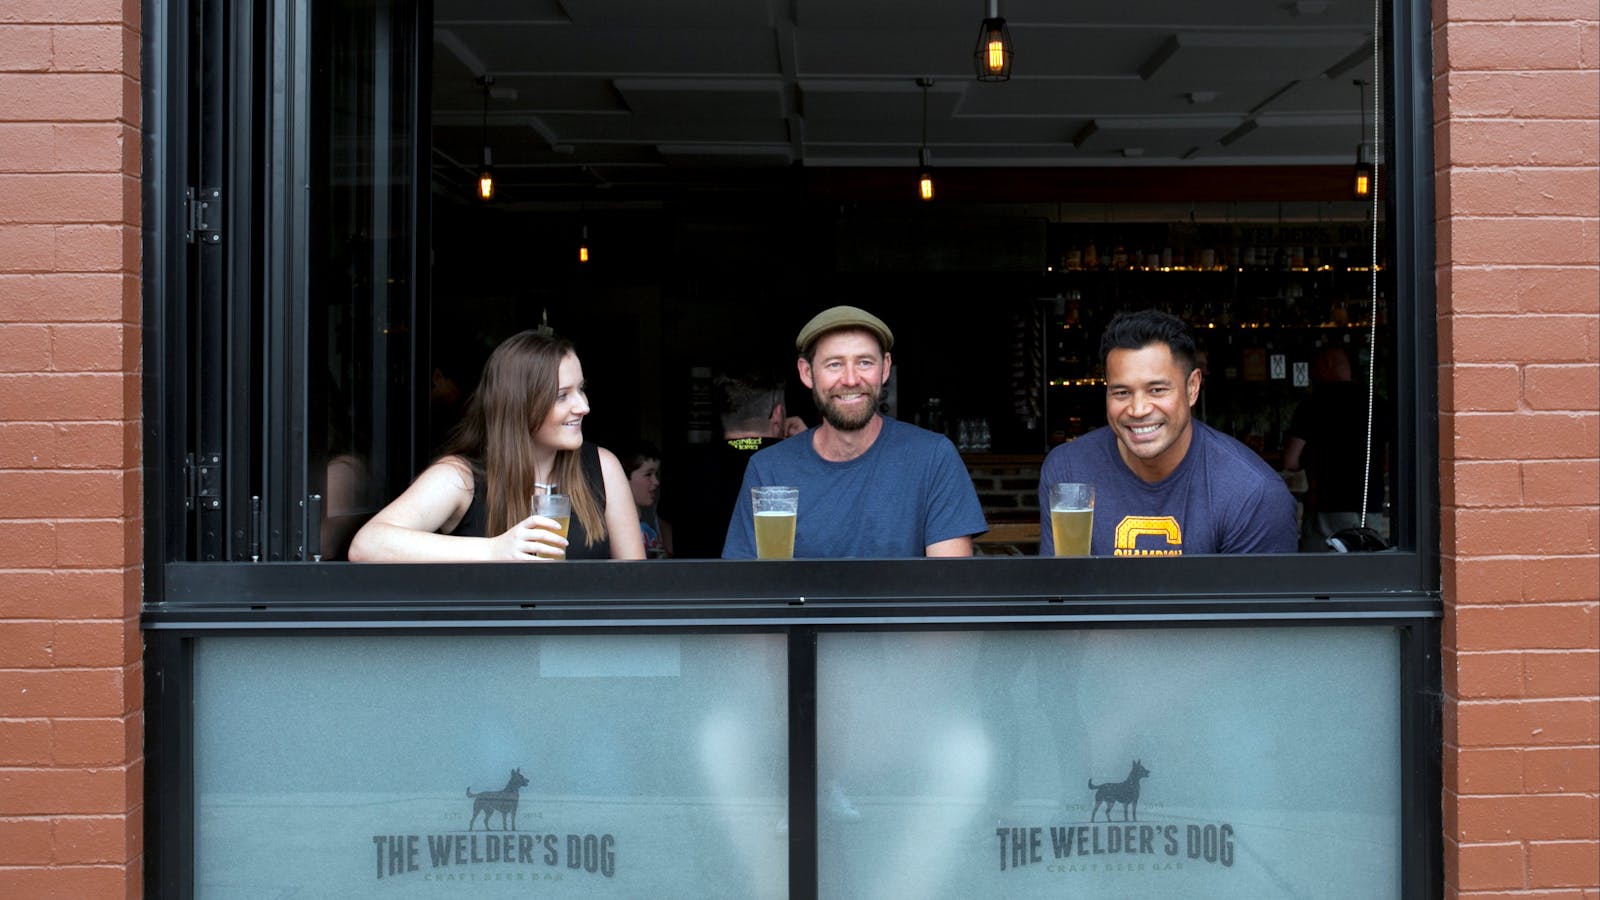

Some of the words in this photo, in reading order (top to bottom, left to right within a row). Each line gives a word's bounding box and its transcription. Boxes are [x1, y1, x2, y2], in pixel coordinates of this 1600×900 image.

[373, 835, 419, 879] THE
[428, 834, 558, 868] WELDER'S
[567, 833, 615, 878] DOG
[996, 827, 1042, 871] THE
[1050, 825, 1178, 859] WELDER'S
[1187, 824, 1234, 867] DOG
[424, 873, 476, 881] CRAFT
[484, 873, 524, 881] BEER
[532, 873, 563, 881] BAR
[1046, 864, 1097, 872] CRAFT
[1105, 863, 1145, 872] BEER
[1152, 862, 1184, 870] BAR
